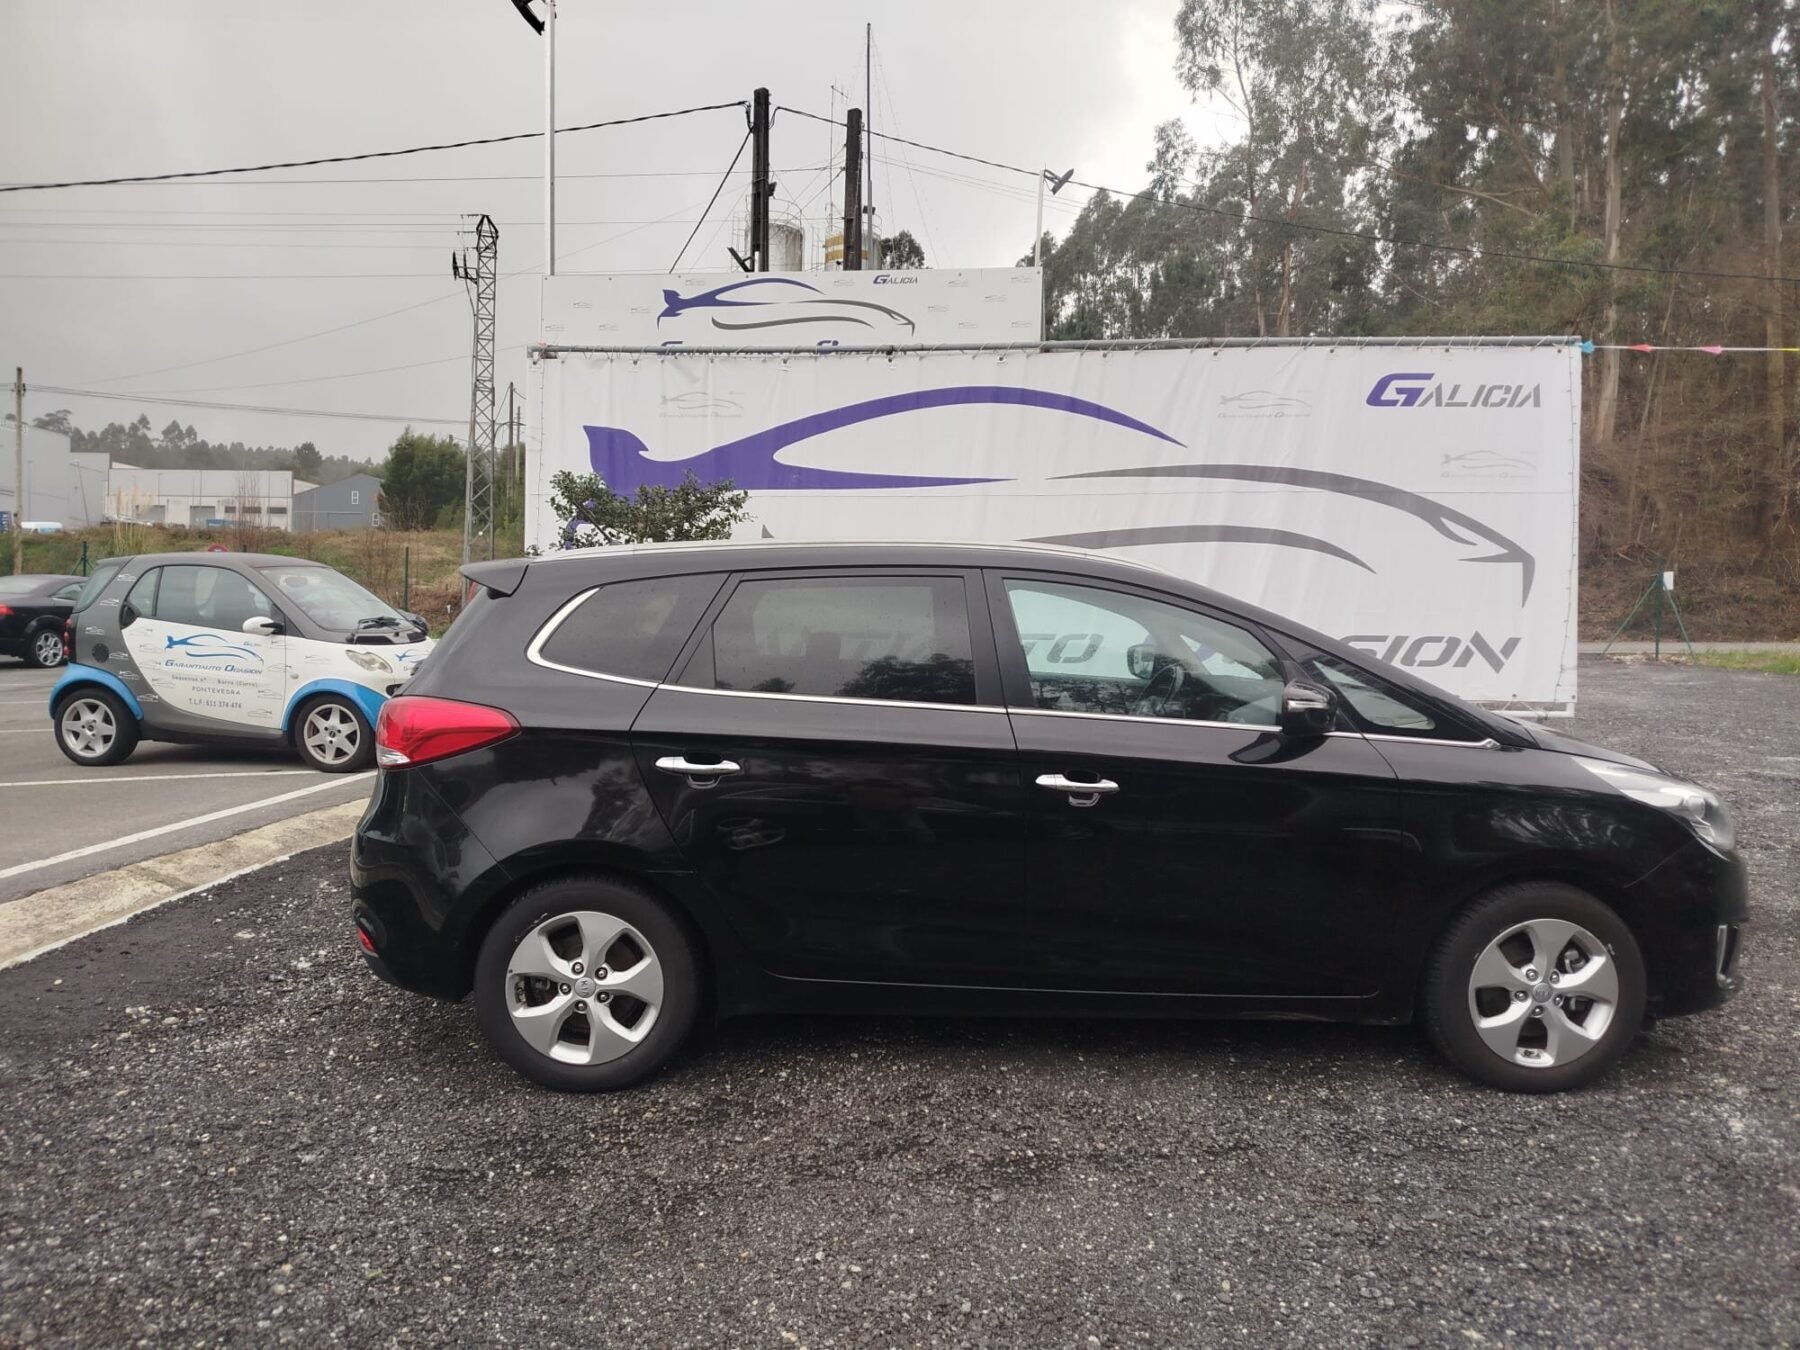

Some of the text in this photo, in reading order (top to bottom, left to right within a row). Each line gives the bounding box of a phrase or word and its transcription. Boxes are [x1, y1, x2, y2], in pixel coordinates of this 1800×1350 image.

[872, 274, 918, 285] GALICIA
[1365, 372, 1542, 409] GALICIA
[192, 686, 241, 695] PONTEVEDRA
